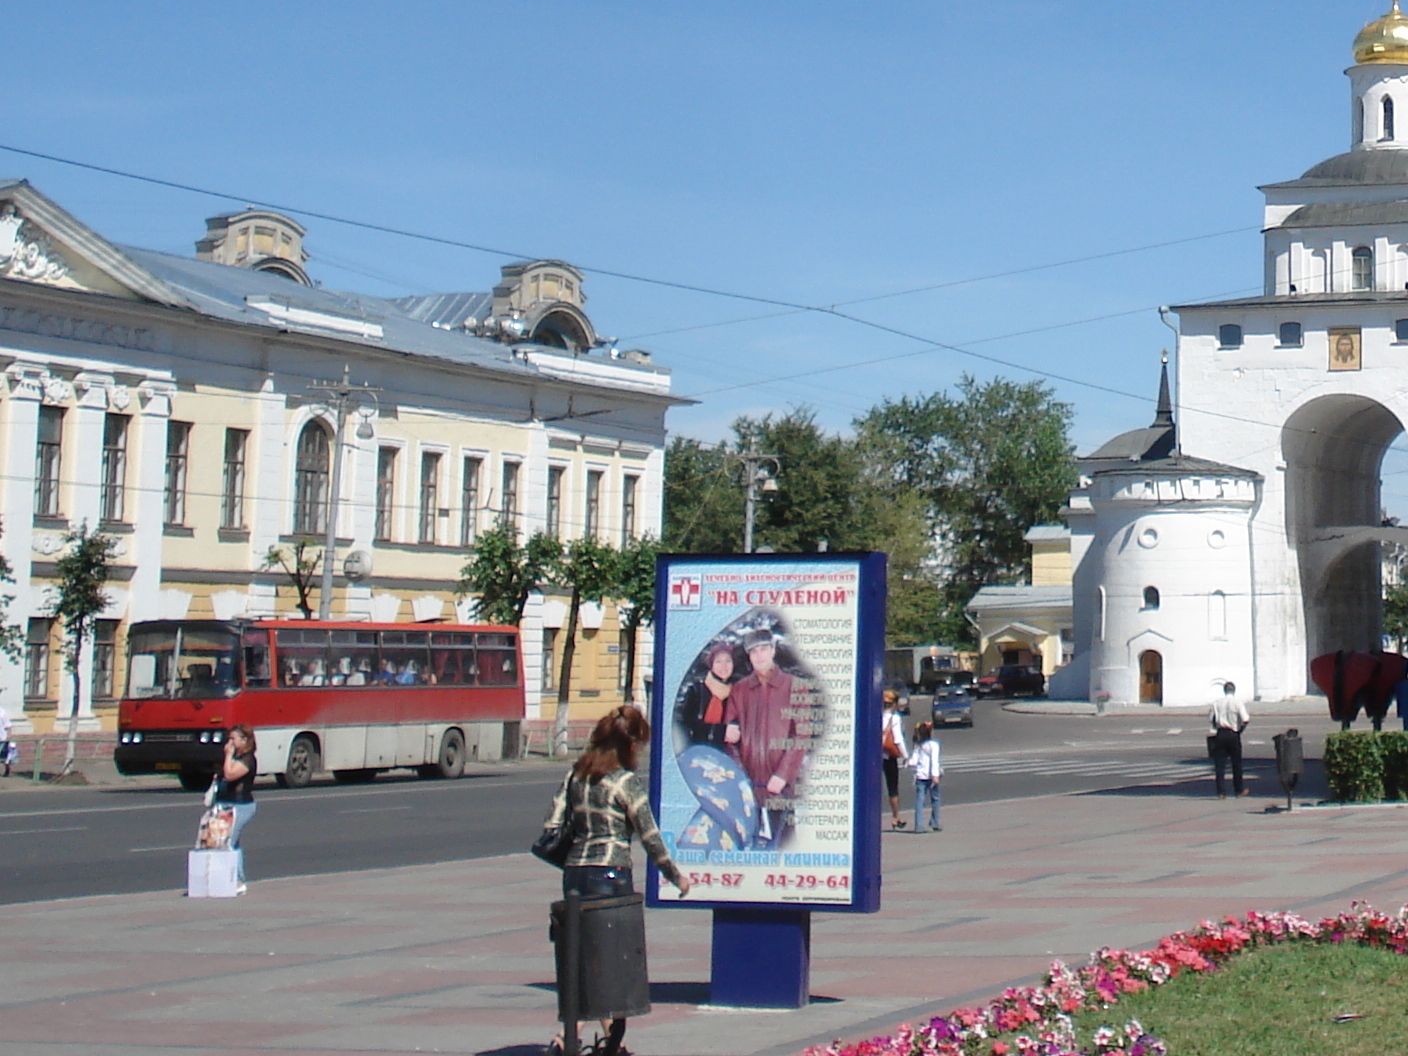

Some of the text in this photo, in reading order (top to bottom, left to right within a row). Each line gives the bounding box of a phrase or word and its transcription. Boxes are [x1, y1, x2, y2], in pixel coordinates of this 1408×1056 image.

[793, 618, 852, 630] СТОМАТОЛОГИЯ
[816, 754, 850, 765] ТЕРАПИЯ
[815, 830, 849, 841] МАССАЖ
[709, 847, 780, 865] семейная
[784, 852, 850, 866] клиника
[764, 874, 850, 889] 44-29-64
